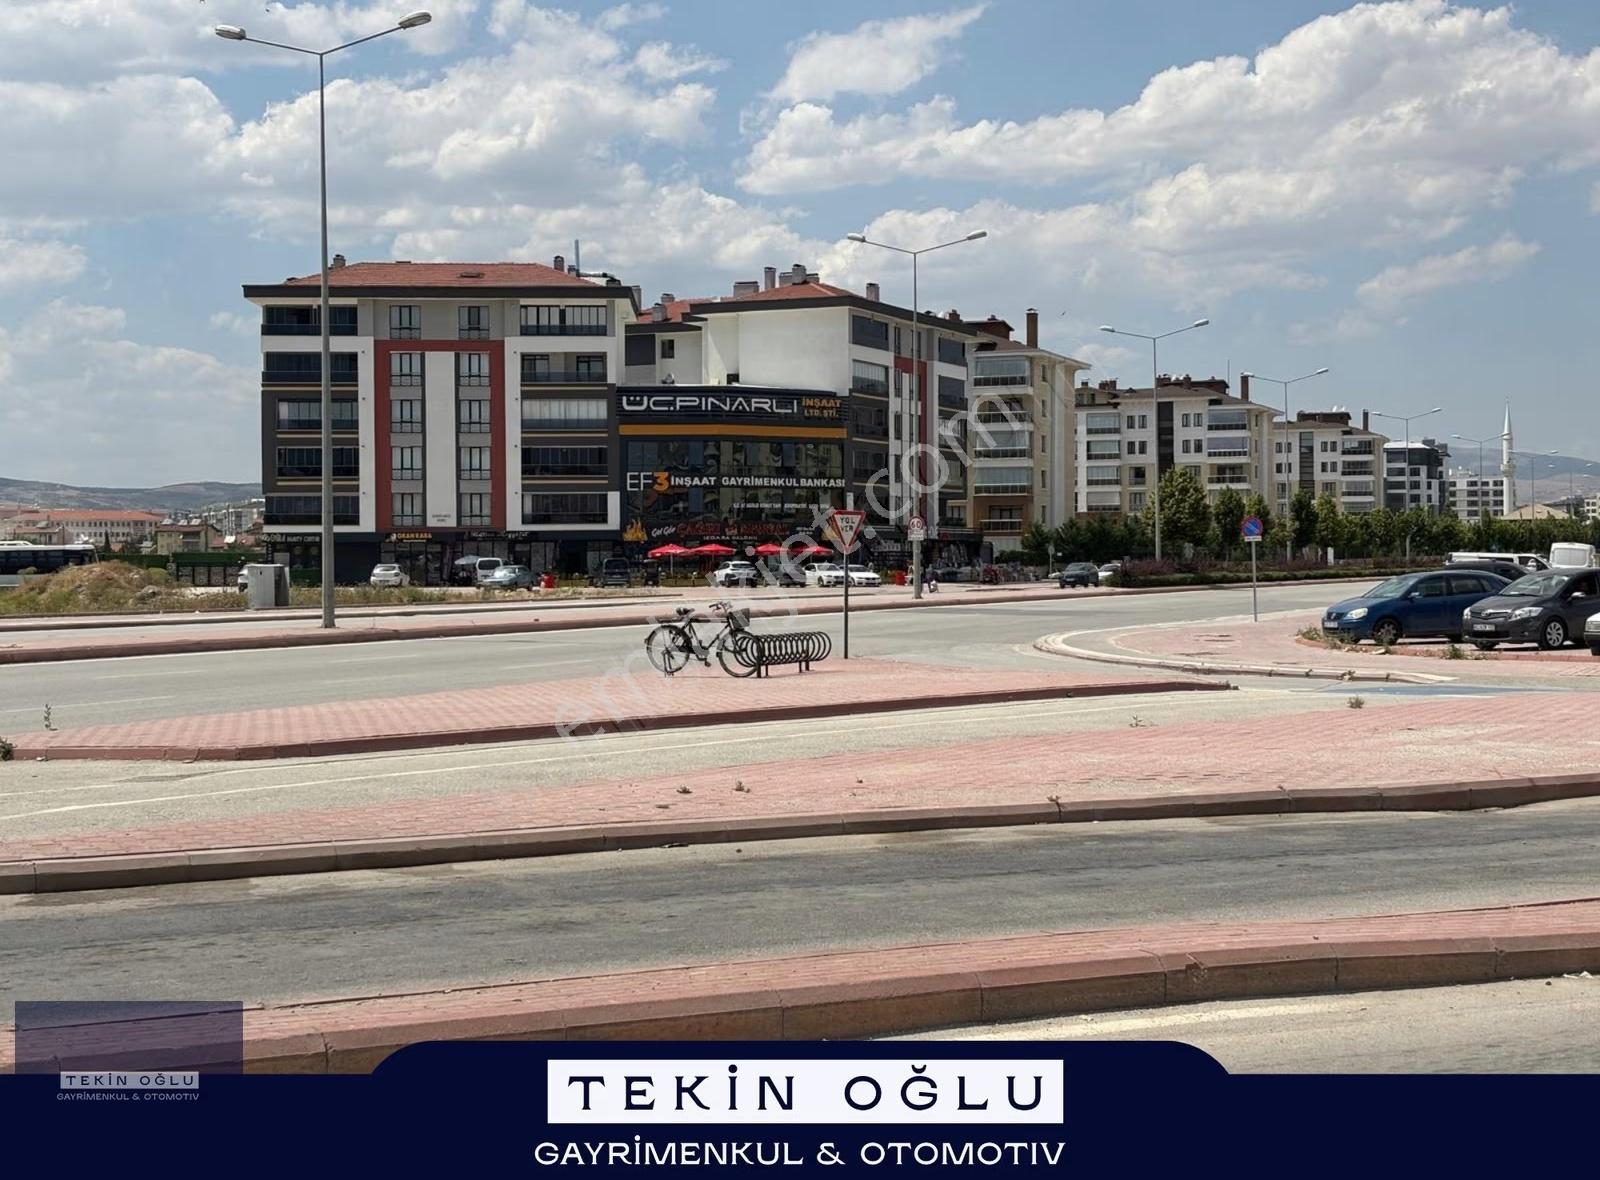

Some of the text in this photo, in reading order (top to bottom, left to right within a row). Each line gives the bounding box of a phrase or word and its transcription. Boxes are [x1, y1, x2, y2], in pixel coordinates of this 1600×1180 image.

[670, 475, 717, 487] İNŞAAT
[721, 474, 799, 488] GAYRİMENKUL
[800, 478, 846, 488] BANKASI
[839, 516, 856, 525] YOL
